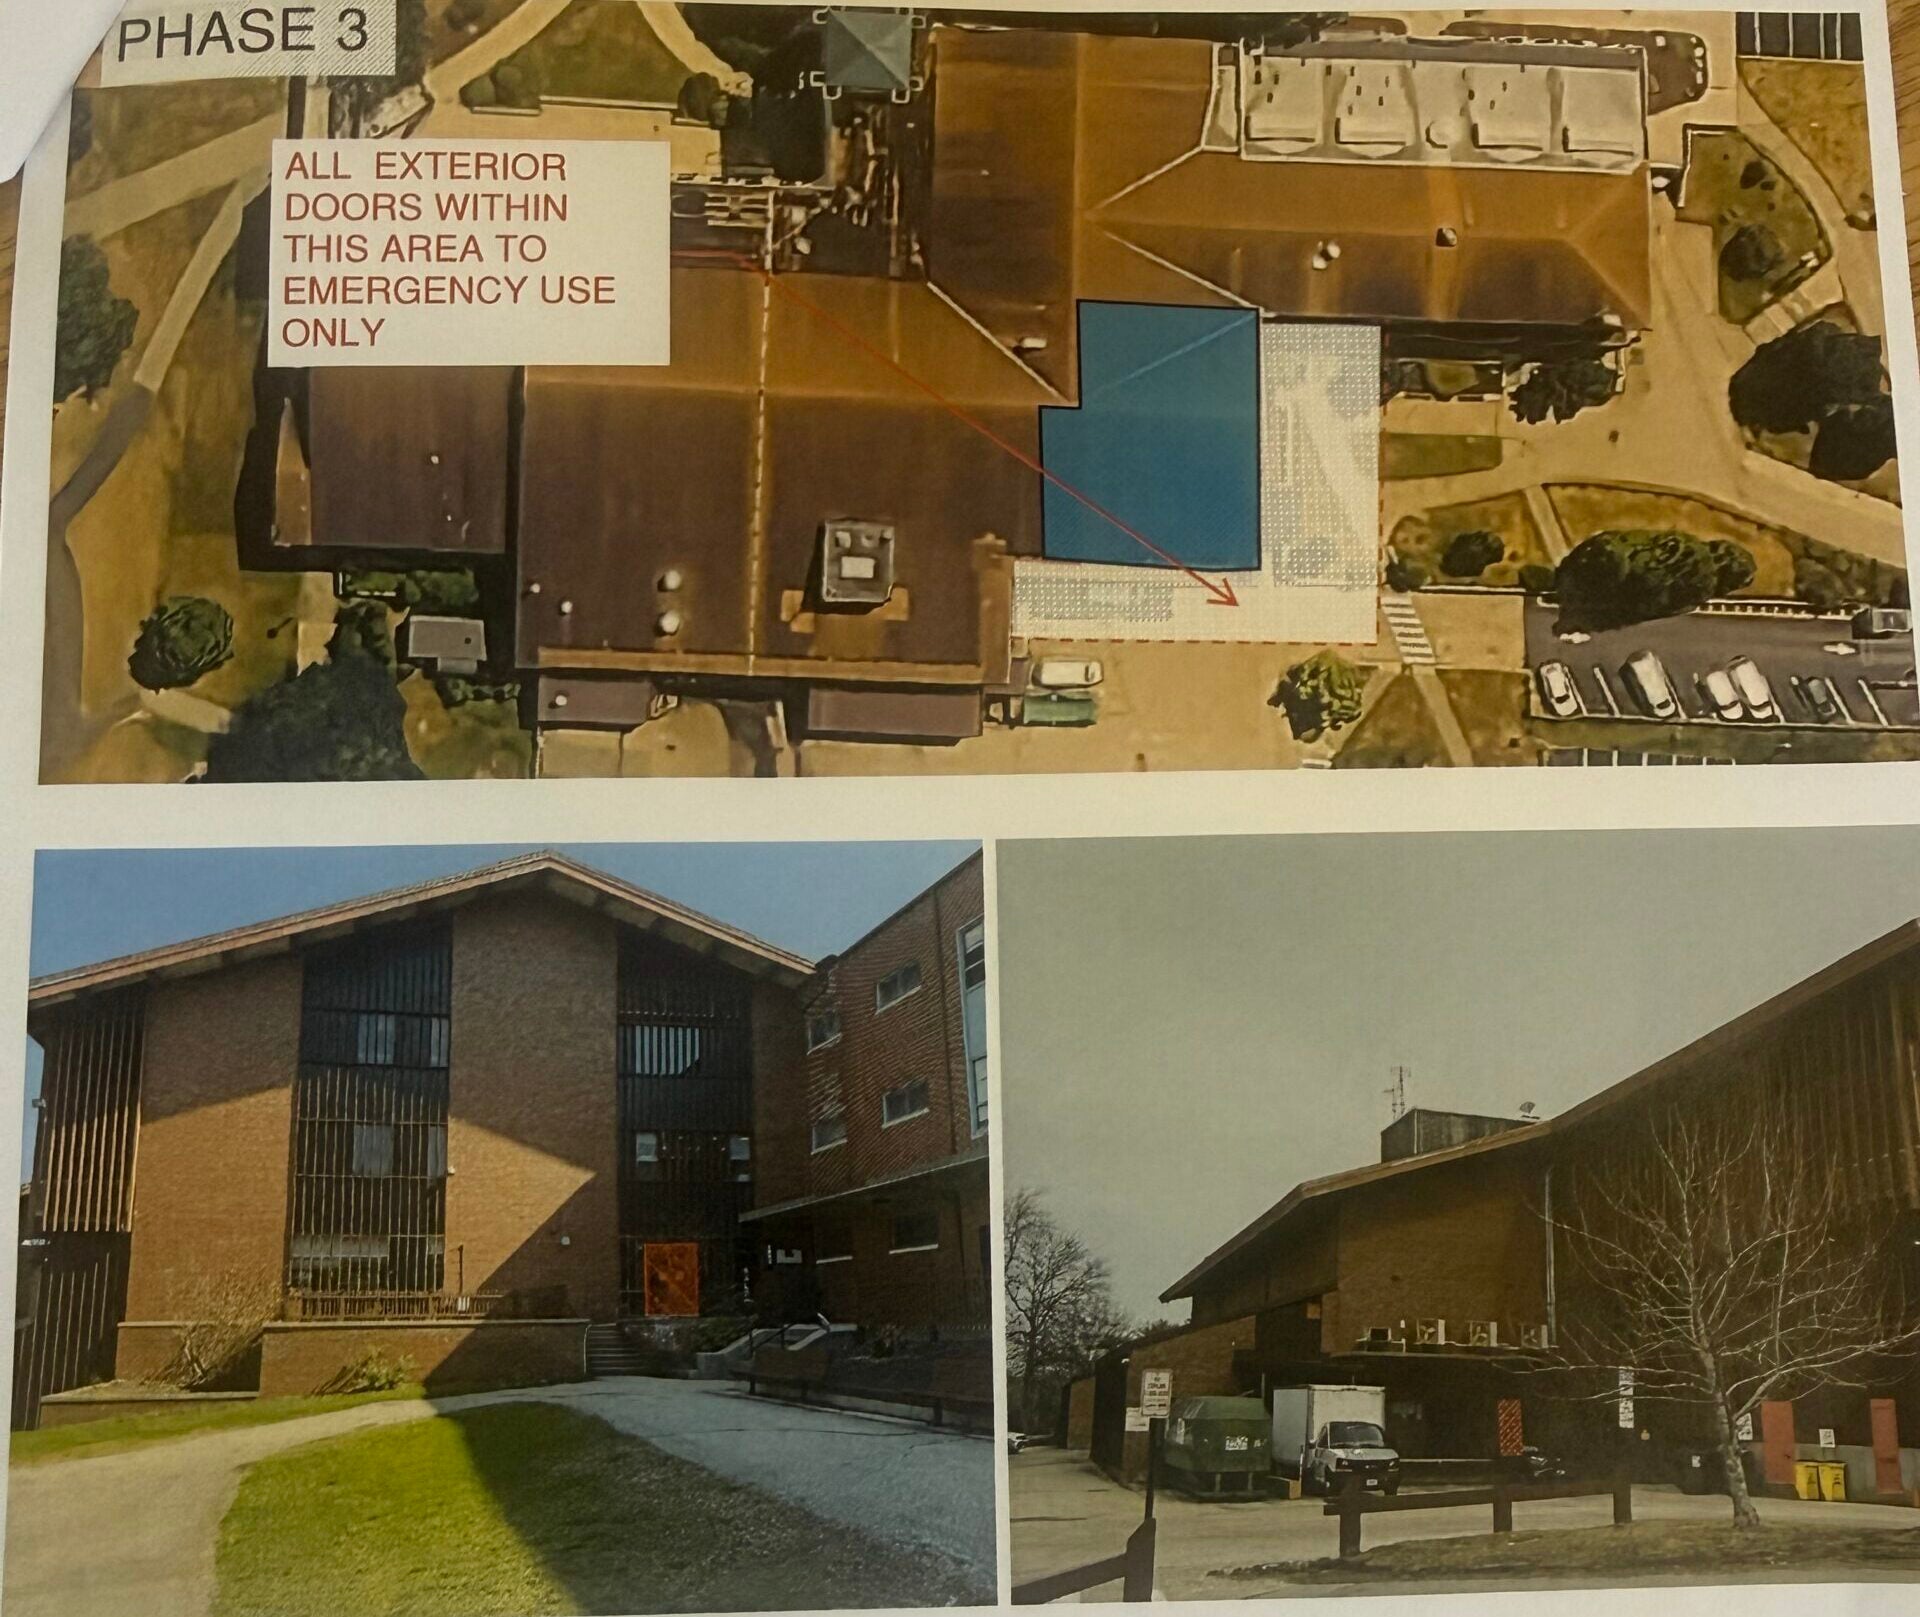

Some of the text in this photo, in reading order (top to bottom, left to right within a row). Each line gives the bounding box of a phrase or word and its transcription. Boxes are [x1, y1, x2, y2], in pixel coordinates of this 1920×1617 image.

[118, 7, 368, 62] PHASE 3
[285, 152, 567, 181] ALL EXTERIOR
[285, 193, 568, 222] DOORS WITHIN
[283, 234, 547, 263] THIS AREA TO
[283, 275, 616, 305] EMERGENCY USE
[281, 318, 385, 348] ONLY
